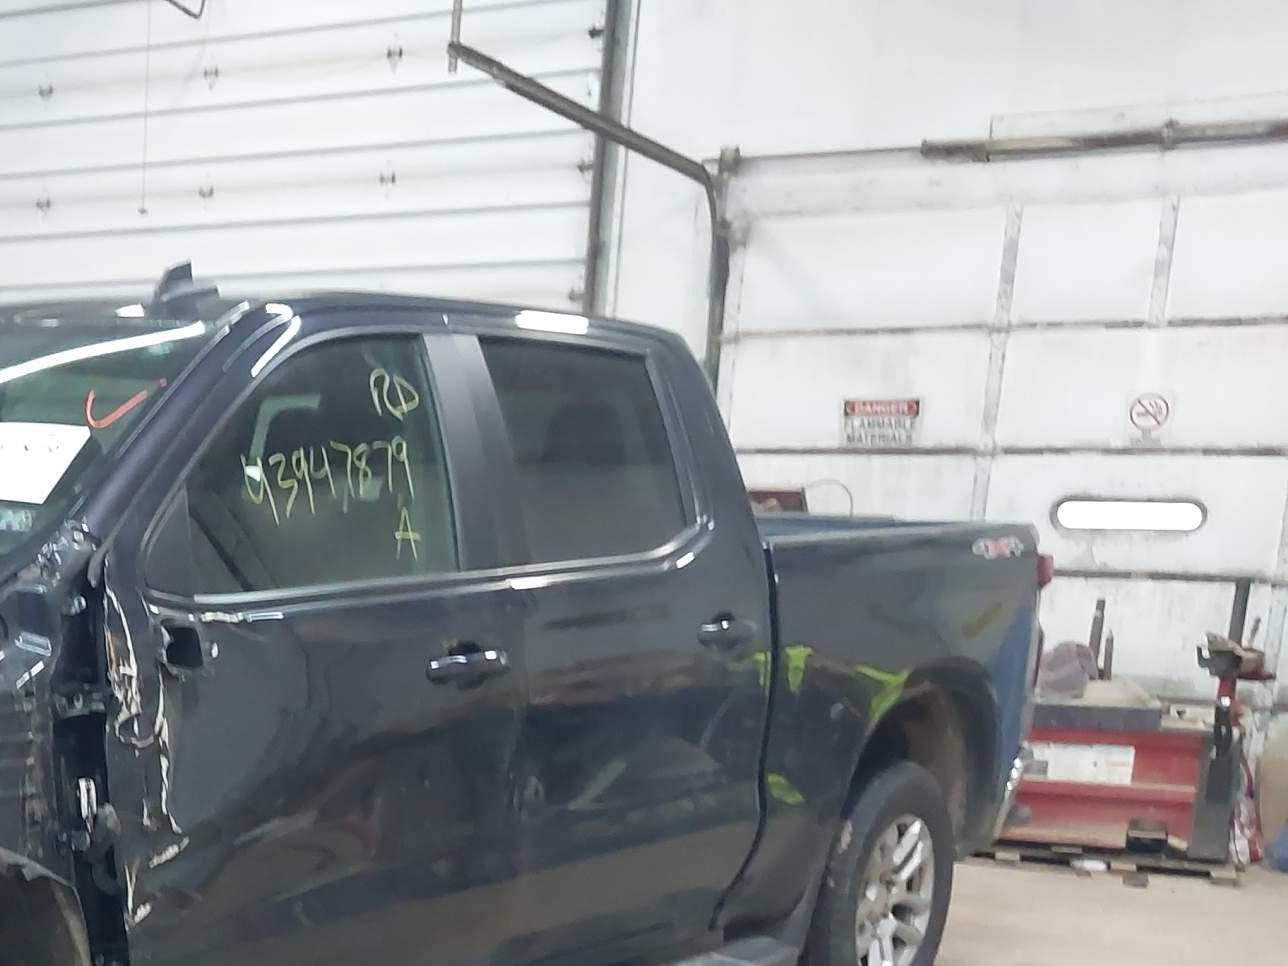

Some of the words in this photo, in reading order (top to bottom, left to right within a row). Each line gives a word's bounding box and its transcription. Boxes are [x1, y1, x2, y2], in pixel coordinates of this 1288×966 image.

[852, 401, 909, 415] DANGER
[844, 418, 915, 430] FLAMMABLE
[846, 431, 913, 444] MATERIALS
[240, 435, 415, 527] 43947879
[394, 506, 422, 560] A
